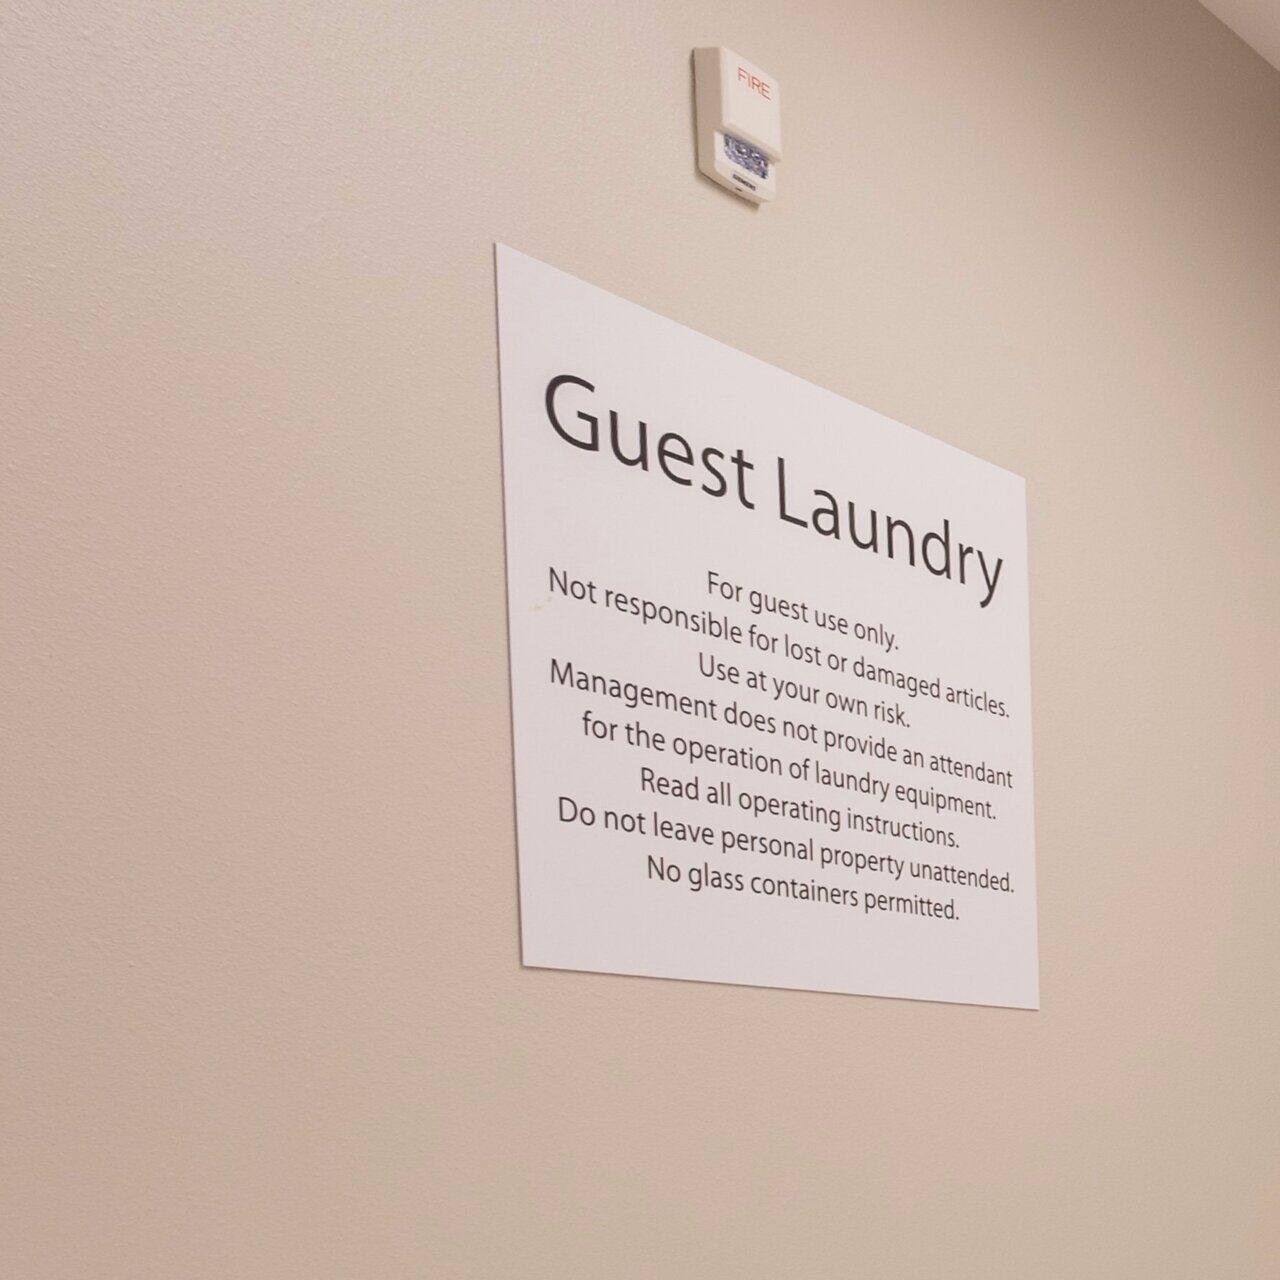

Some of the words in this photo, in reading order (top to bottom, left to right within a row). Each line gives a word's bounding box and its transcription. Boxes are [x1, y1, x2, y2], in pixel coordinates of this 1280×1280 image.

[738, 67, 771, 101] FIRE
[544, 374, 756, 511] Guest
[776, 456, 1004, 609] Laundry
[548, 566, 598, 605] Not
[604, 589, 743, 645] responsible
[747, 623, 779, 654] for
[784, 633, 822, 667] lost
[827, 653, 848, 673] or
[852, 655, 941, 700] damaged
[945, 686, 1010, 718] articles.
[707, 570, 744, 603] For
[749, 590, 809, 624] guest
[814, 609, 849, 636] use
[853, 622, 899, 654] only.
[550, 657, 718, 722] Management
[723, 700, 777, 735] does
[782, 720, 819, 745] not
[823, 729, 898, 762] provide
[902, 748, 925, 769] an
[929, 754, 1014, 789] attendant
[698, 651, 740, 685] Use
[745, 670, 768, 692] at
[772, 677, 821, 705] your
[825, 691, 868, 718] own
[873, 700, 911, 729] risk.
[581, 709, 619, 742] for
[624, 720, 666, 752] the
[672, 737, 783, 776] operation
[788, 757, 811, 782] of
[815, 760, 891, 803] laundry
[894, 784, 997, 820] equipment.
[640, 766, 700, 801] Read
[706, 780, 732, 807] all
[738, 792, 841, 833] operating
[847, 807, 960, 849] instructions.
[558, 796, 596, 827] Do
[603, 810, 647, 836] not
[653, 810, 715, 846] leave
[721, 830, 814, 862] personal
[820, 846, 905, 881] property
[909, 861, 1015, 894] unattended.
[647, 854, 682, 883] No
[687, 861, 745, 893] glass
[750, 876, 859, 908] containers
[864, 892, 960, 921] permitted.
